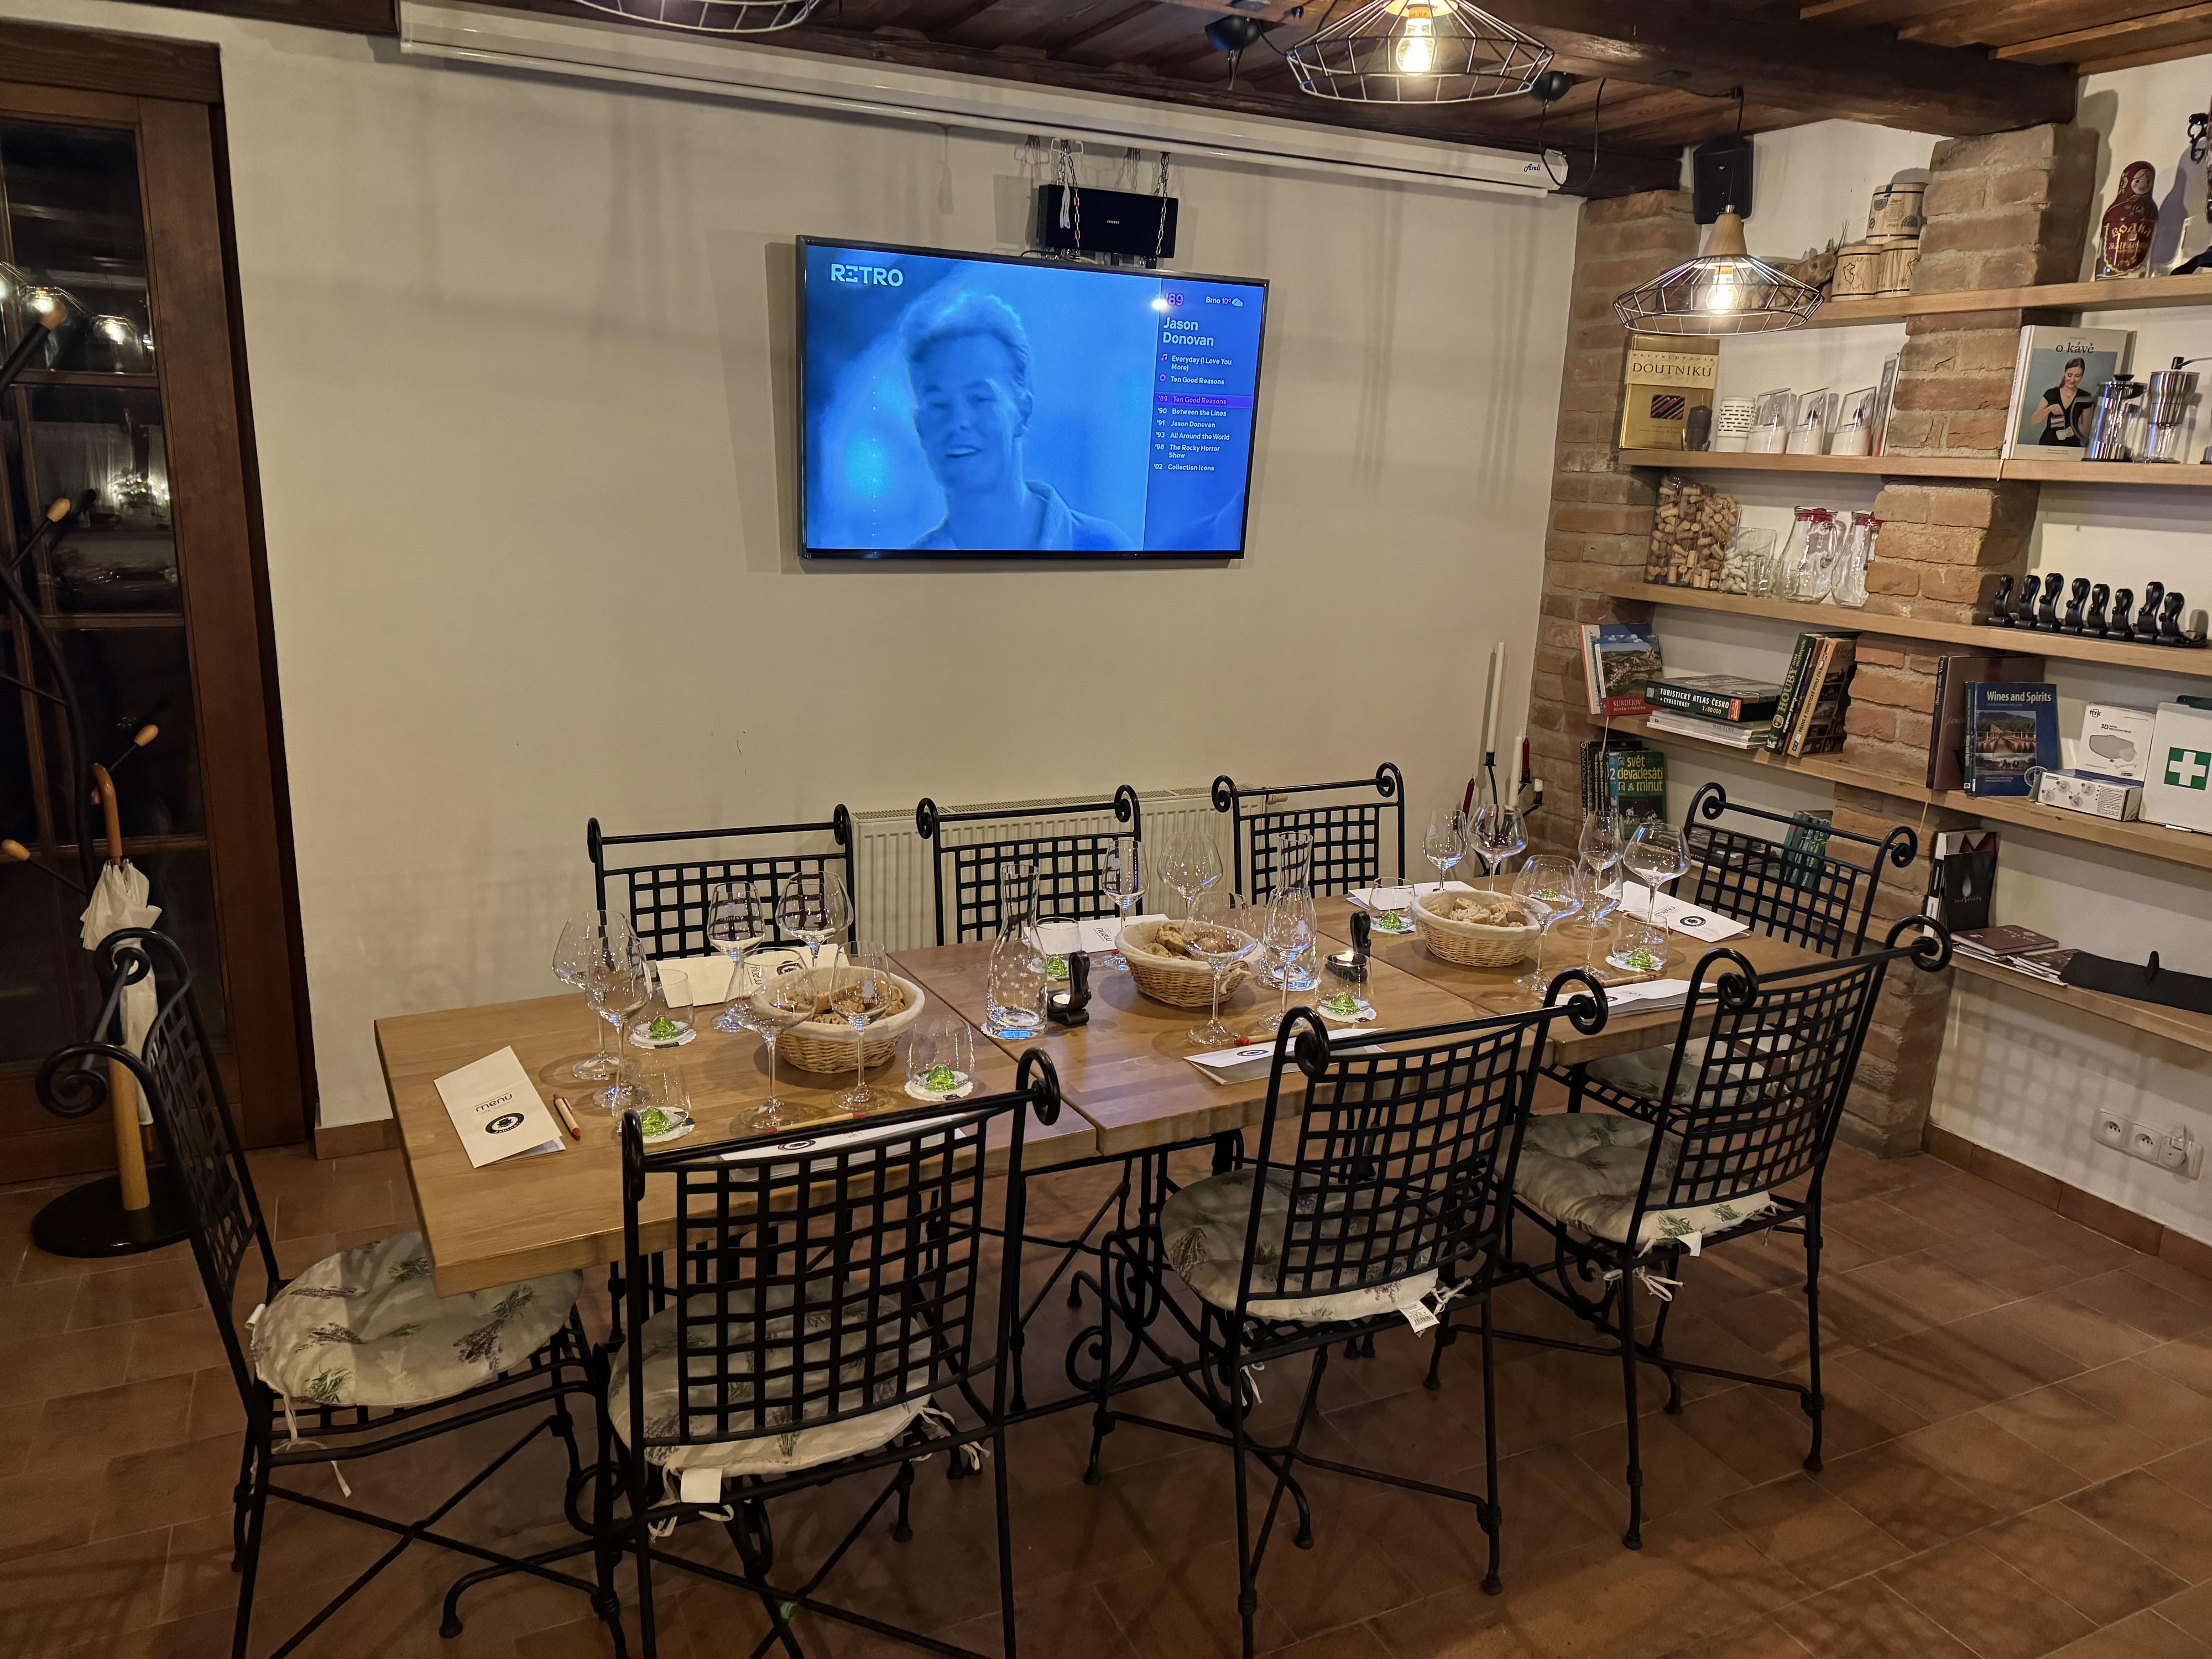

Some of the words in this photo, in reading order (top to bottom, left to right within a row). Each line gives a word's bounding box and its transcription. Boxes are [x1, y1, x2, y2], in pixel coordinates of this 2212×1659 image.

[831, 263, 904, 286] RETRO
[1163, 317, 1198, 331] Jason
[1163, 332, 1214, 346] Donovan
[2056, 345, 2063, 353] o
[2067, 341, 2094, 353] kávě
[1172, 356, 1199, 364] Everyday
[1778, 667, 1797, 712] HOUBY
[1660, 688, 1691, 700] TURISTICKÝ
[1692, 695, 1709, 705] ATLAS
[1711, 696, 1730, 709] ČESKO
[1663, 698, 1691, 708] CYKLOTRASY
[1987, 691, 2009, 701] Wines
[2010, 691, 2025, 701] and
[2026, 691, 2052, 704] Spirits
[1627, 755, 1646, 768] svět
[1609, 768, 1616, 780] 2
[1618, 767, 1663, 780] devadesáti
[1636, 779, 1663, 792] minut
[1093, 927, 1113, 942] menu
[475, 1093, 514, 1114] menu
